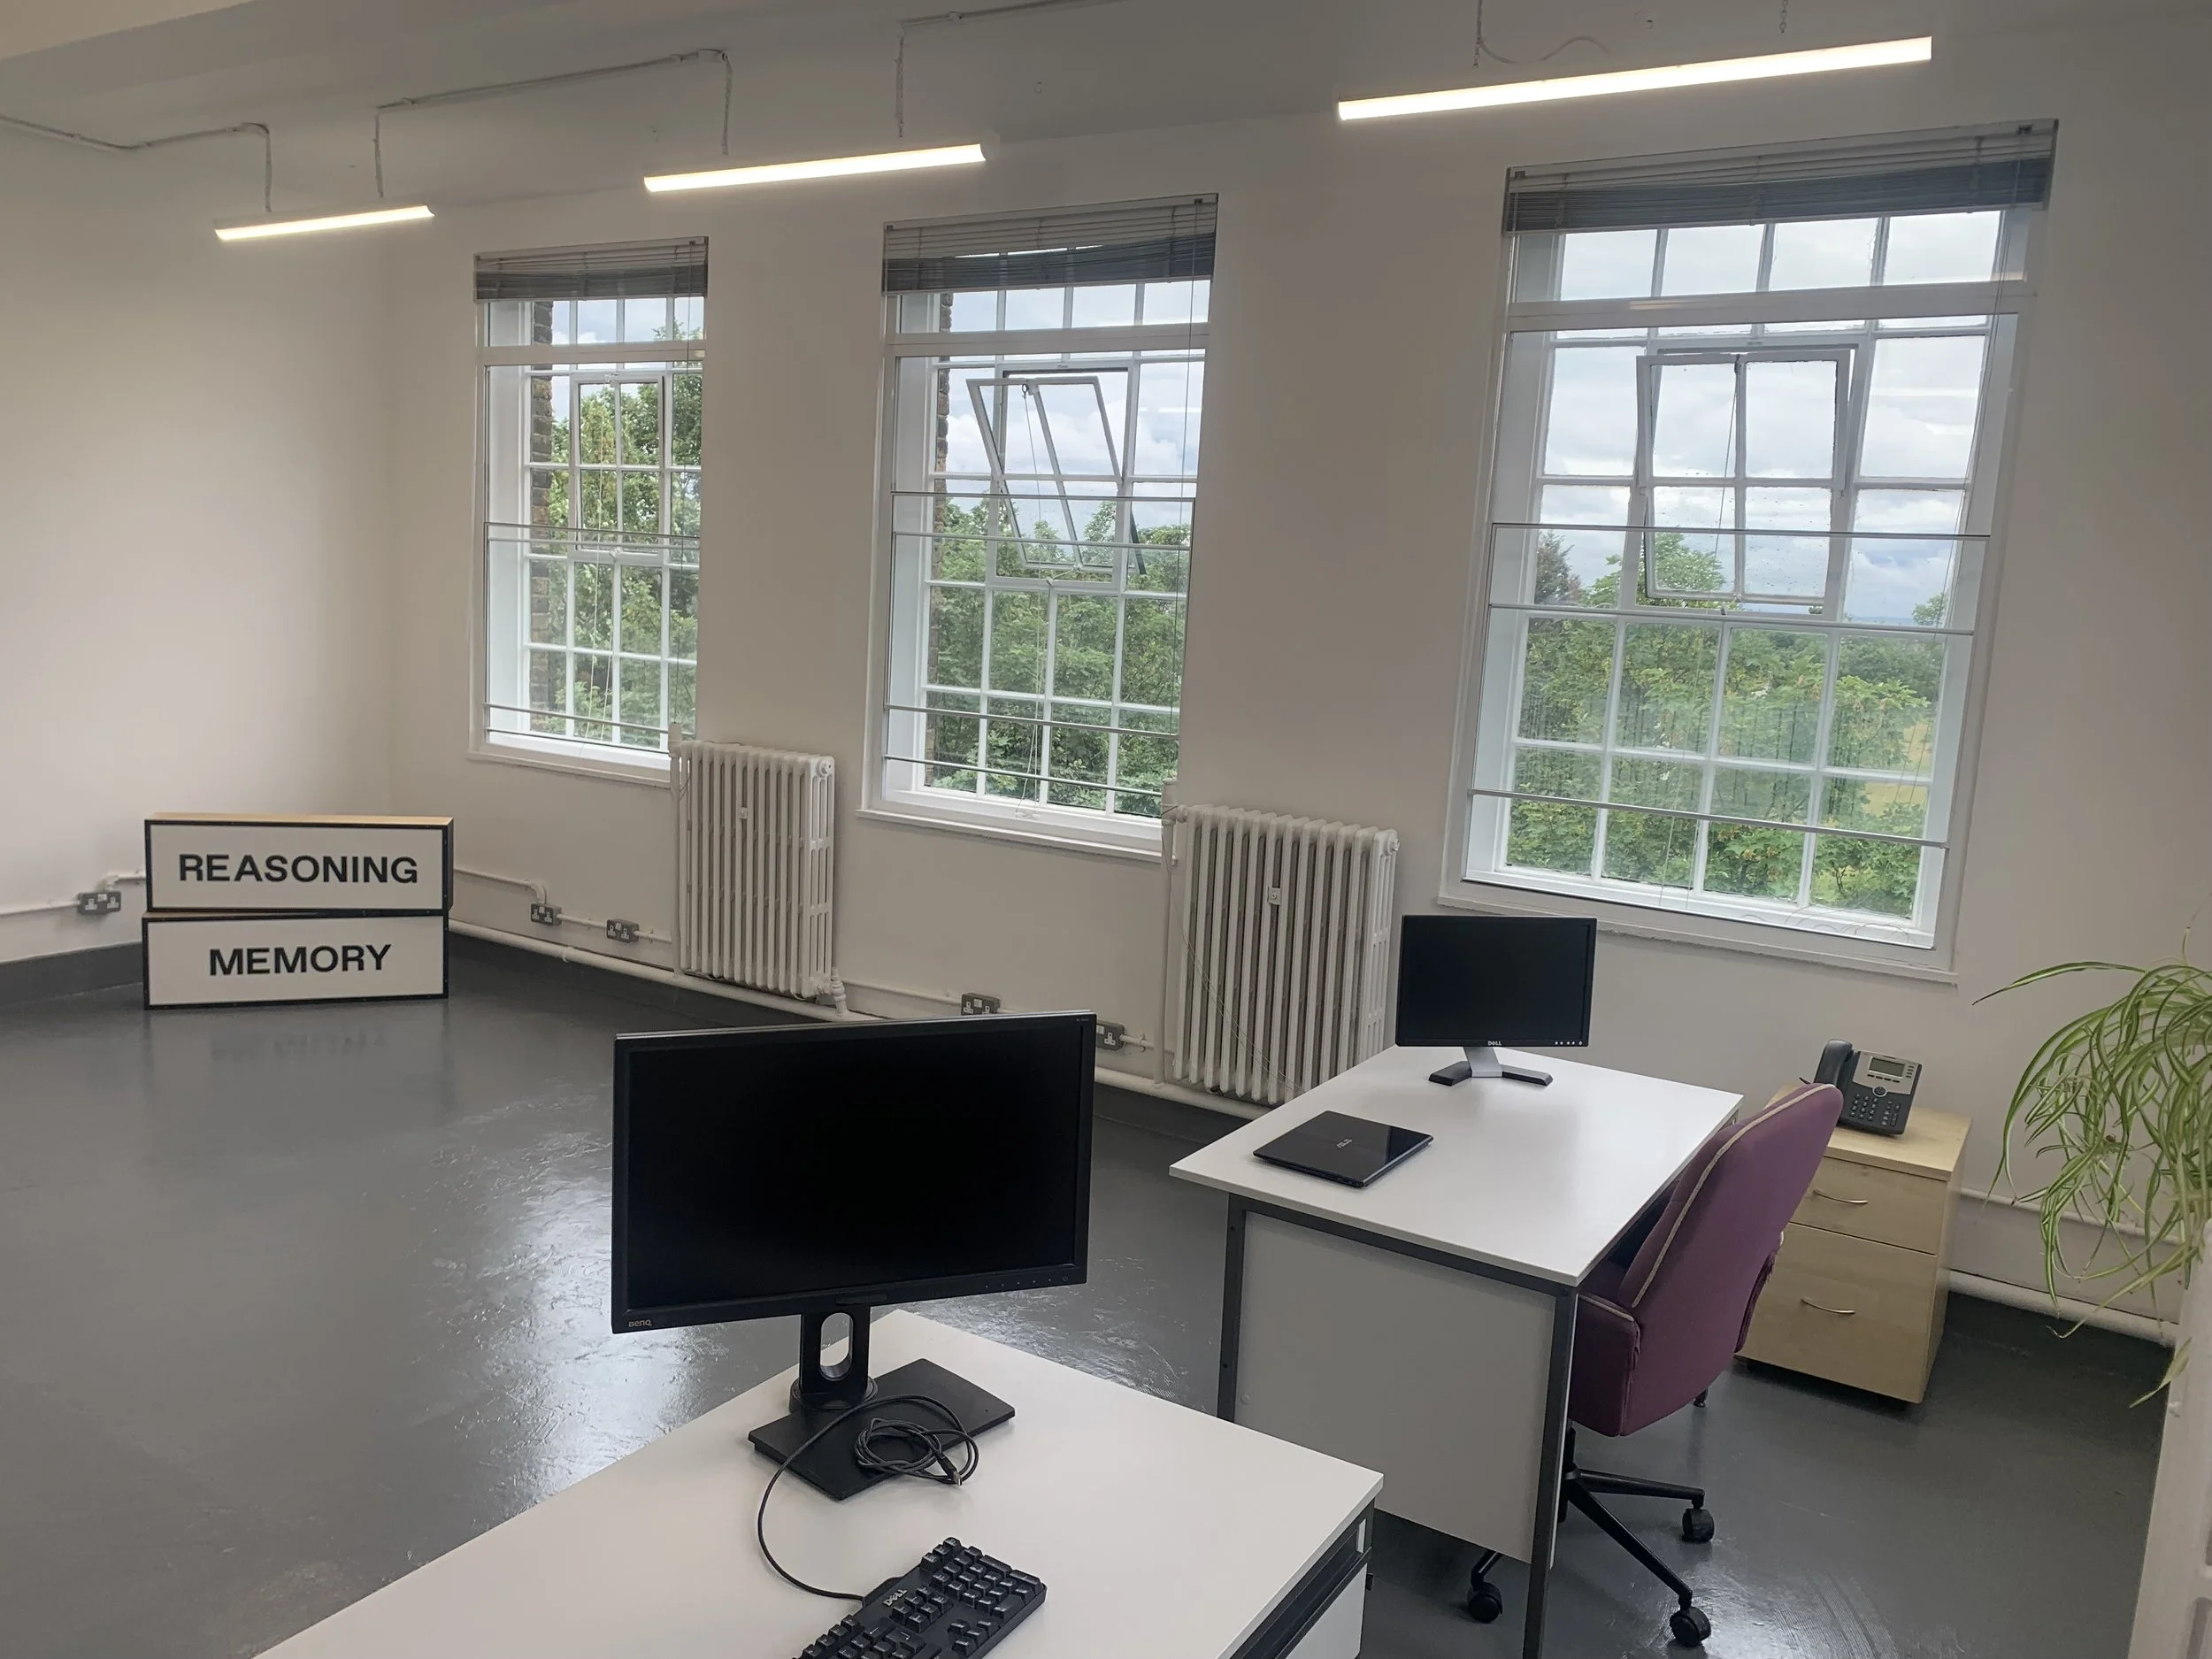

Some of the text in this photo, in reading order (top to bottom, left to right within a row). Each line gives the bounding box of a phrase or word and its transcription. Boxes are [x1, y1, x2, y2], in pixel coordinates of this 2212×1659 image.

[179, 854, 418, 884] REASONING
[210, 943, 392, 976] MEMORY
[882, 1589, 908, 1607] DELL
